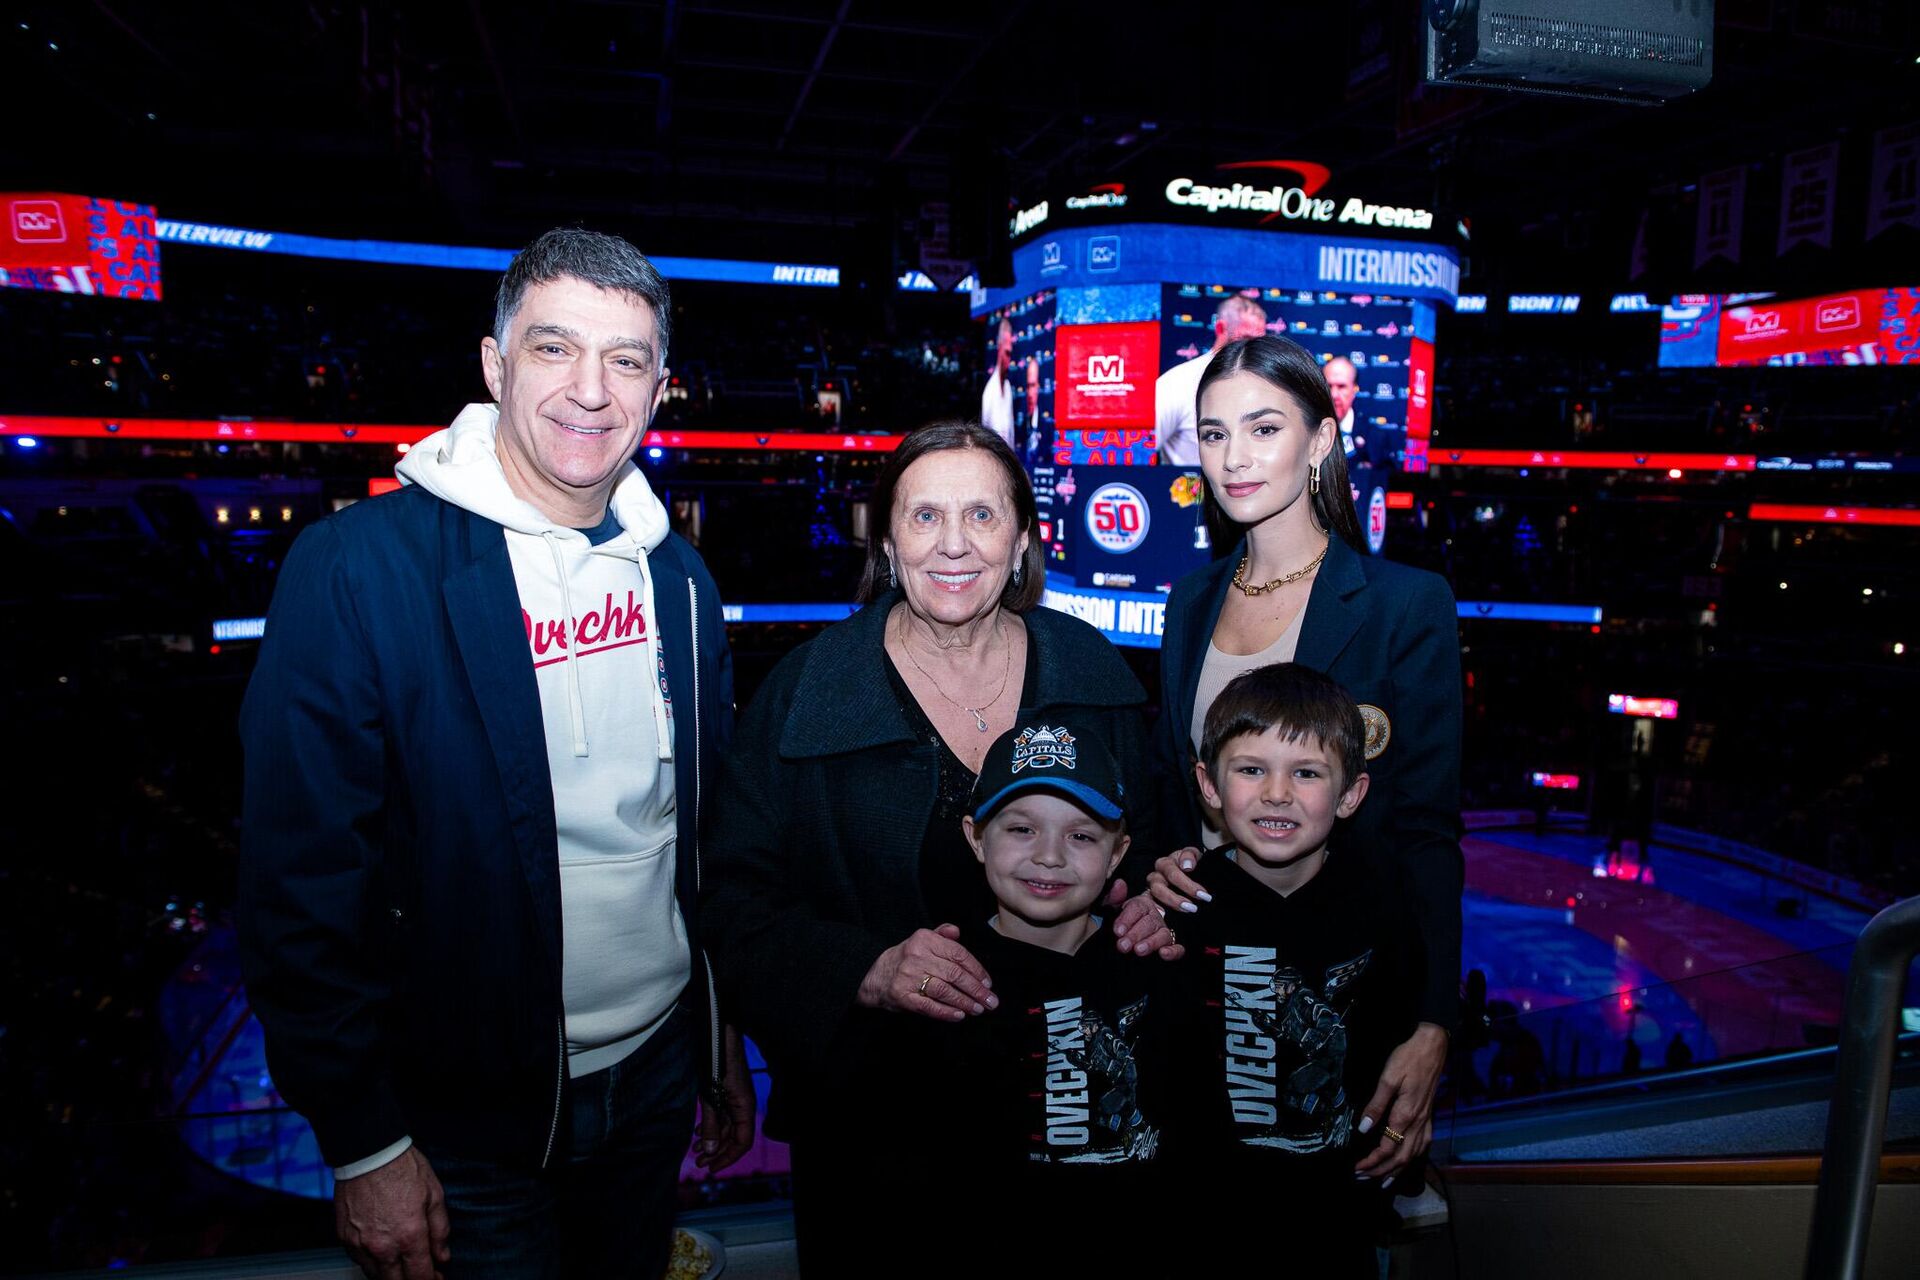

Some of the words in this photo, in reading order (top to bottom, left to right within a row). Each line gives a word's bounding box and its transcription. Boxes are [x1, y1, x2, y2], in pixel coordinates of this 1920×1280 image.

[1338, 198, 1433, 229] Arena
[1094, 502, 1139, 531] 50
[1015, 744, 1074, 759] CAPITALS
